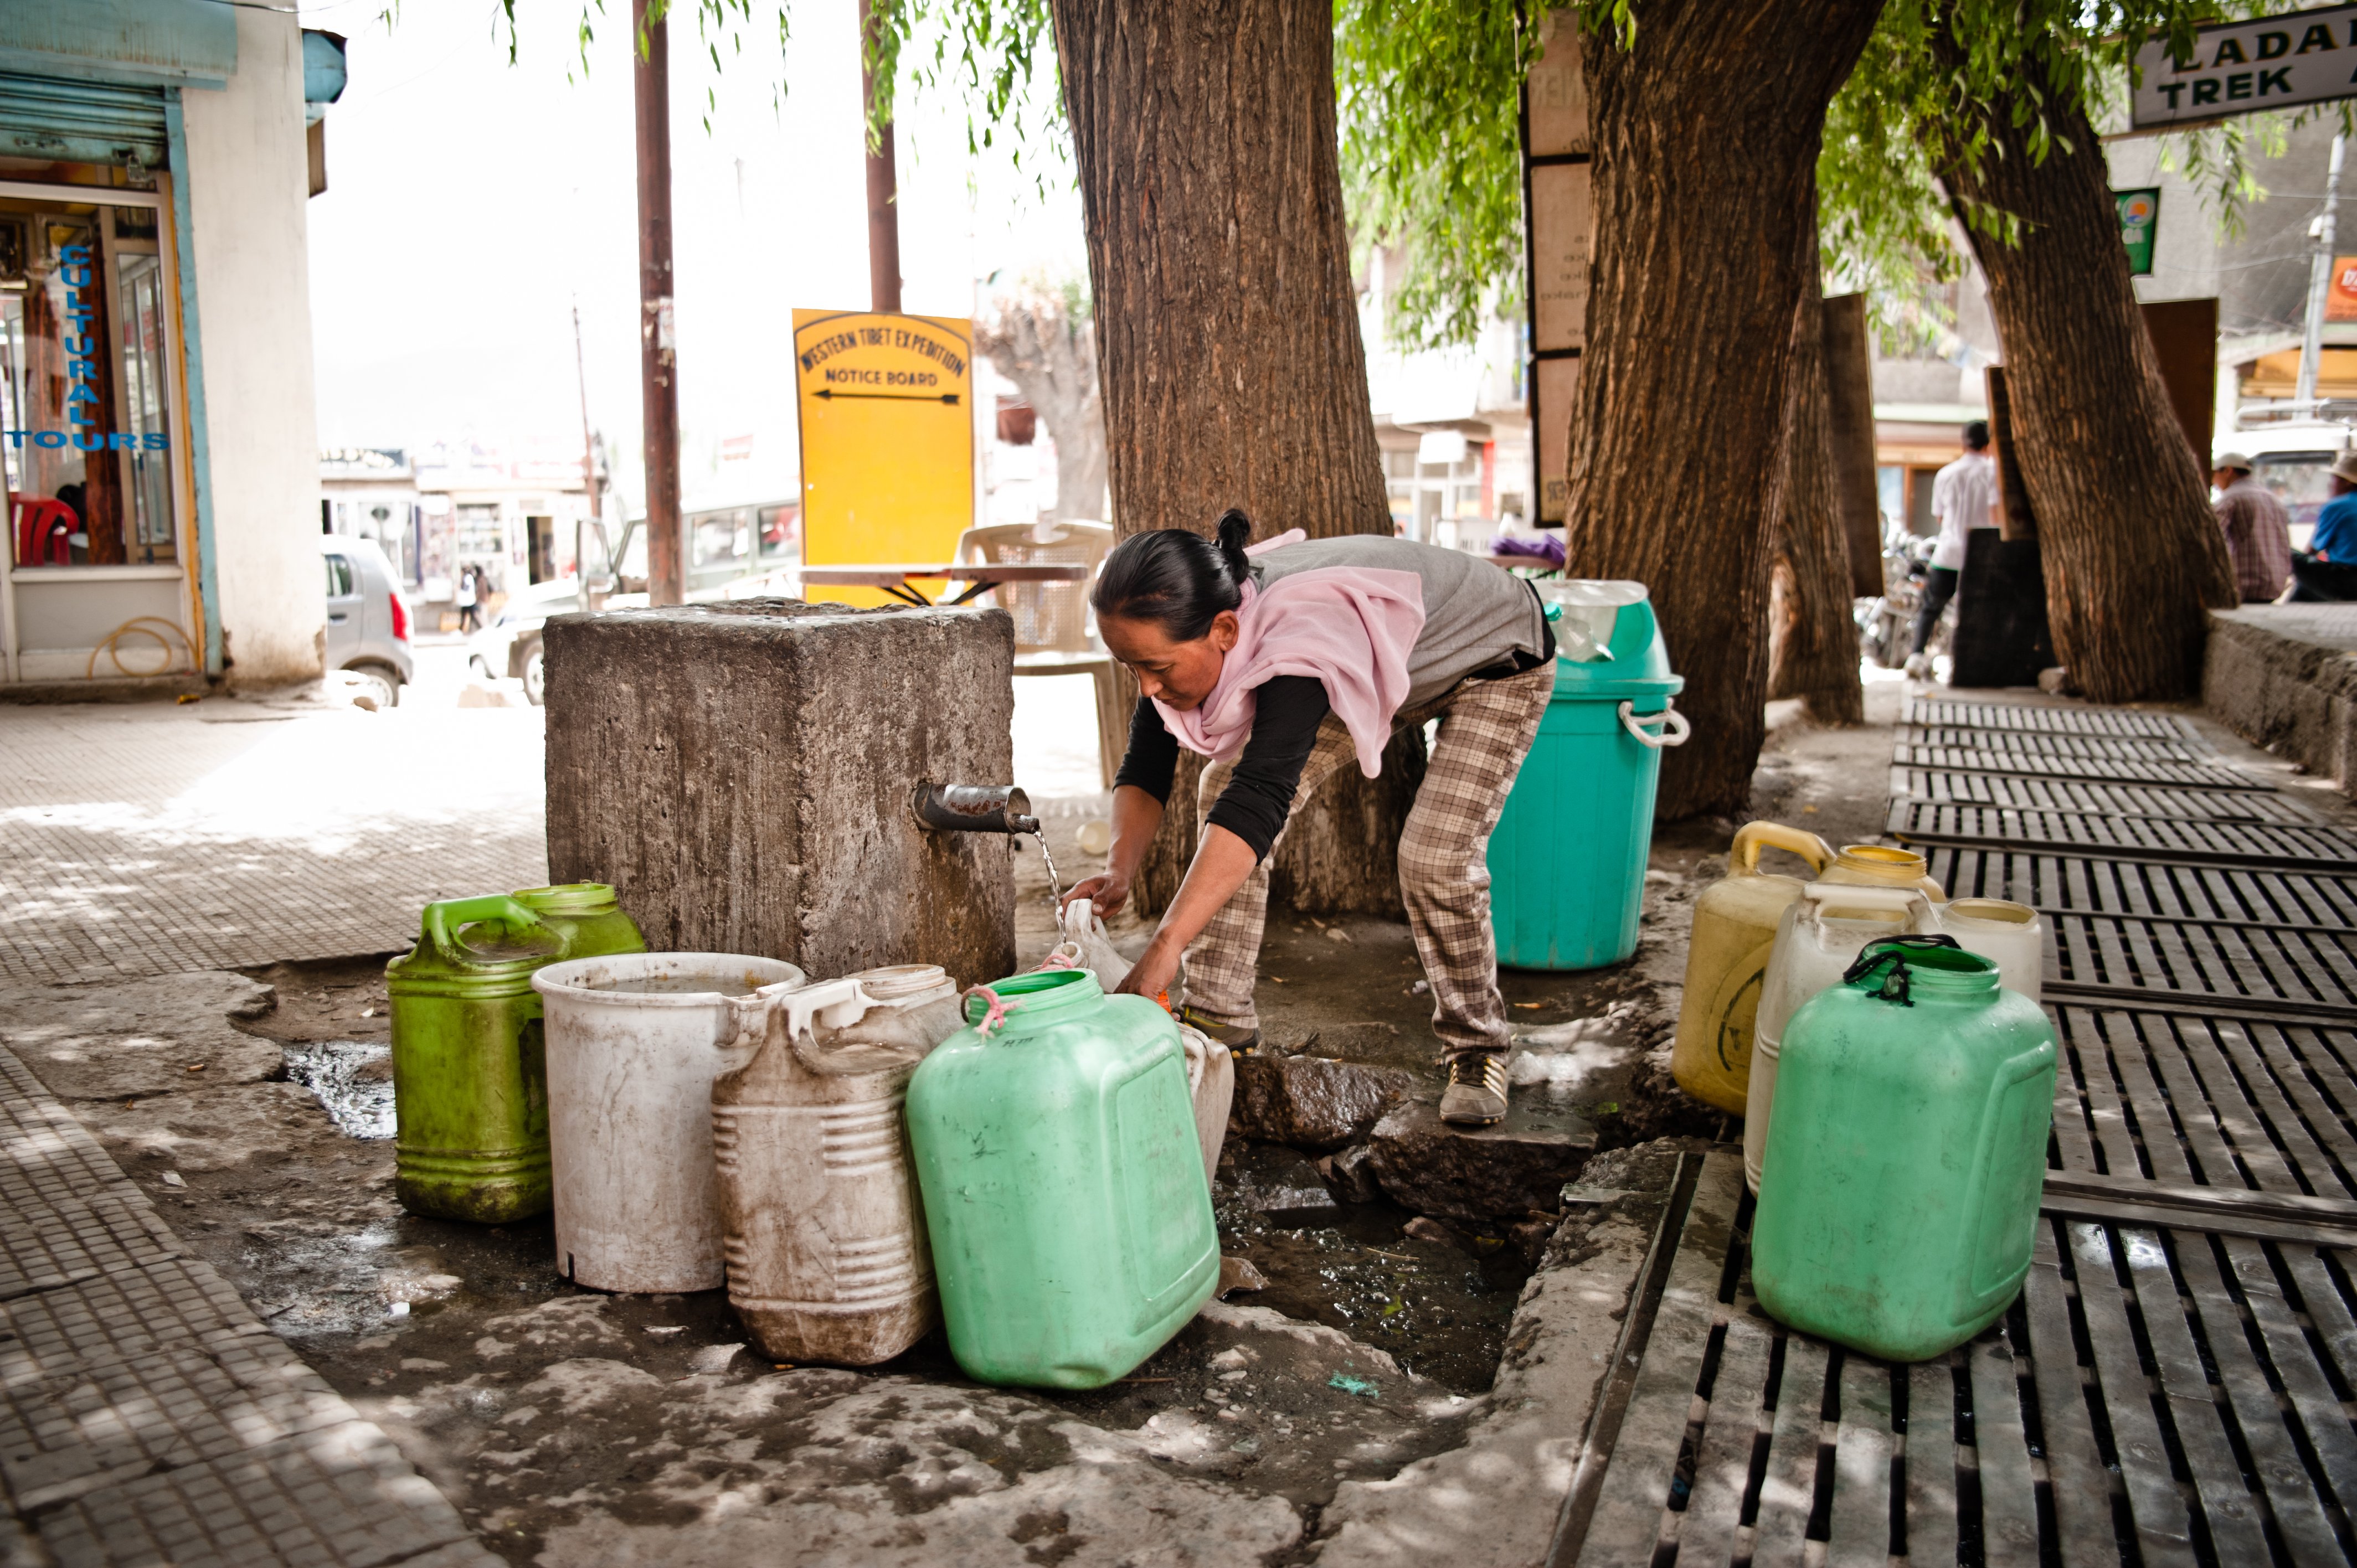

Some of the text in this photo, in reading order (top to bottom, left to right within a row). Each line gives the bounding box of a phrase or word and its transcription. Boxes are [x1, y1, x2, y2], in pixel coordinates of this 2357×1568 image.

[2158, 66, 2293, 109] TREK
[60, 245, 99, 425] CULTURAL
[801, 332, 857, 373] WESTERN
[859, 327, 891, 346] TIBET
[825, 369, 938, 387] NOTICE BOARD
[4, 430, 169, 452] TOURS
